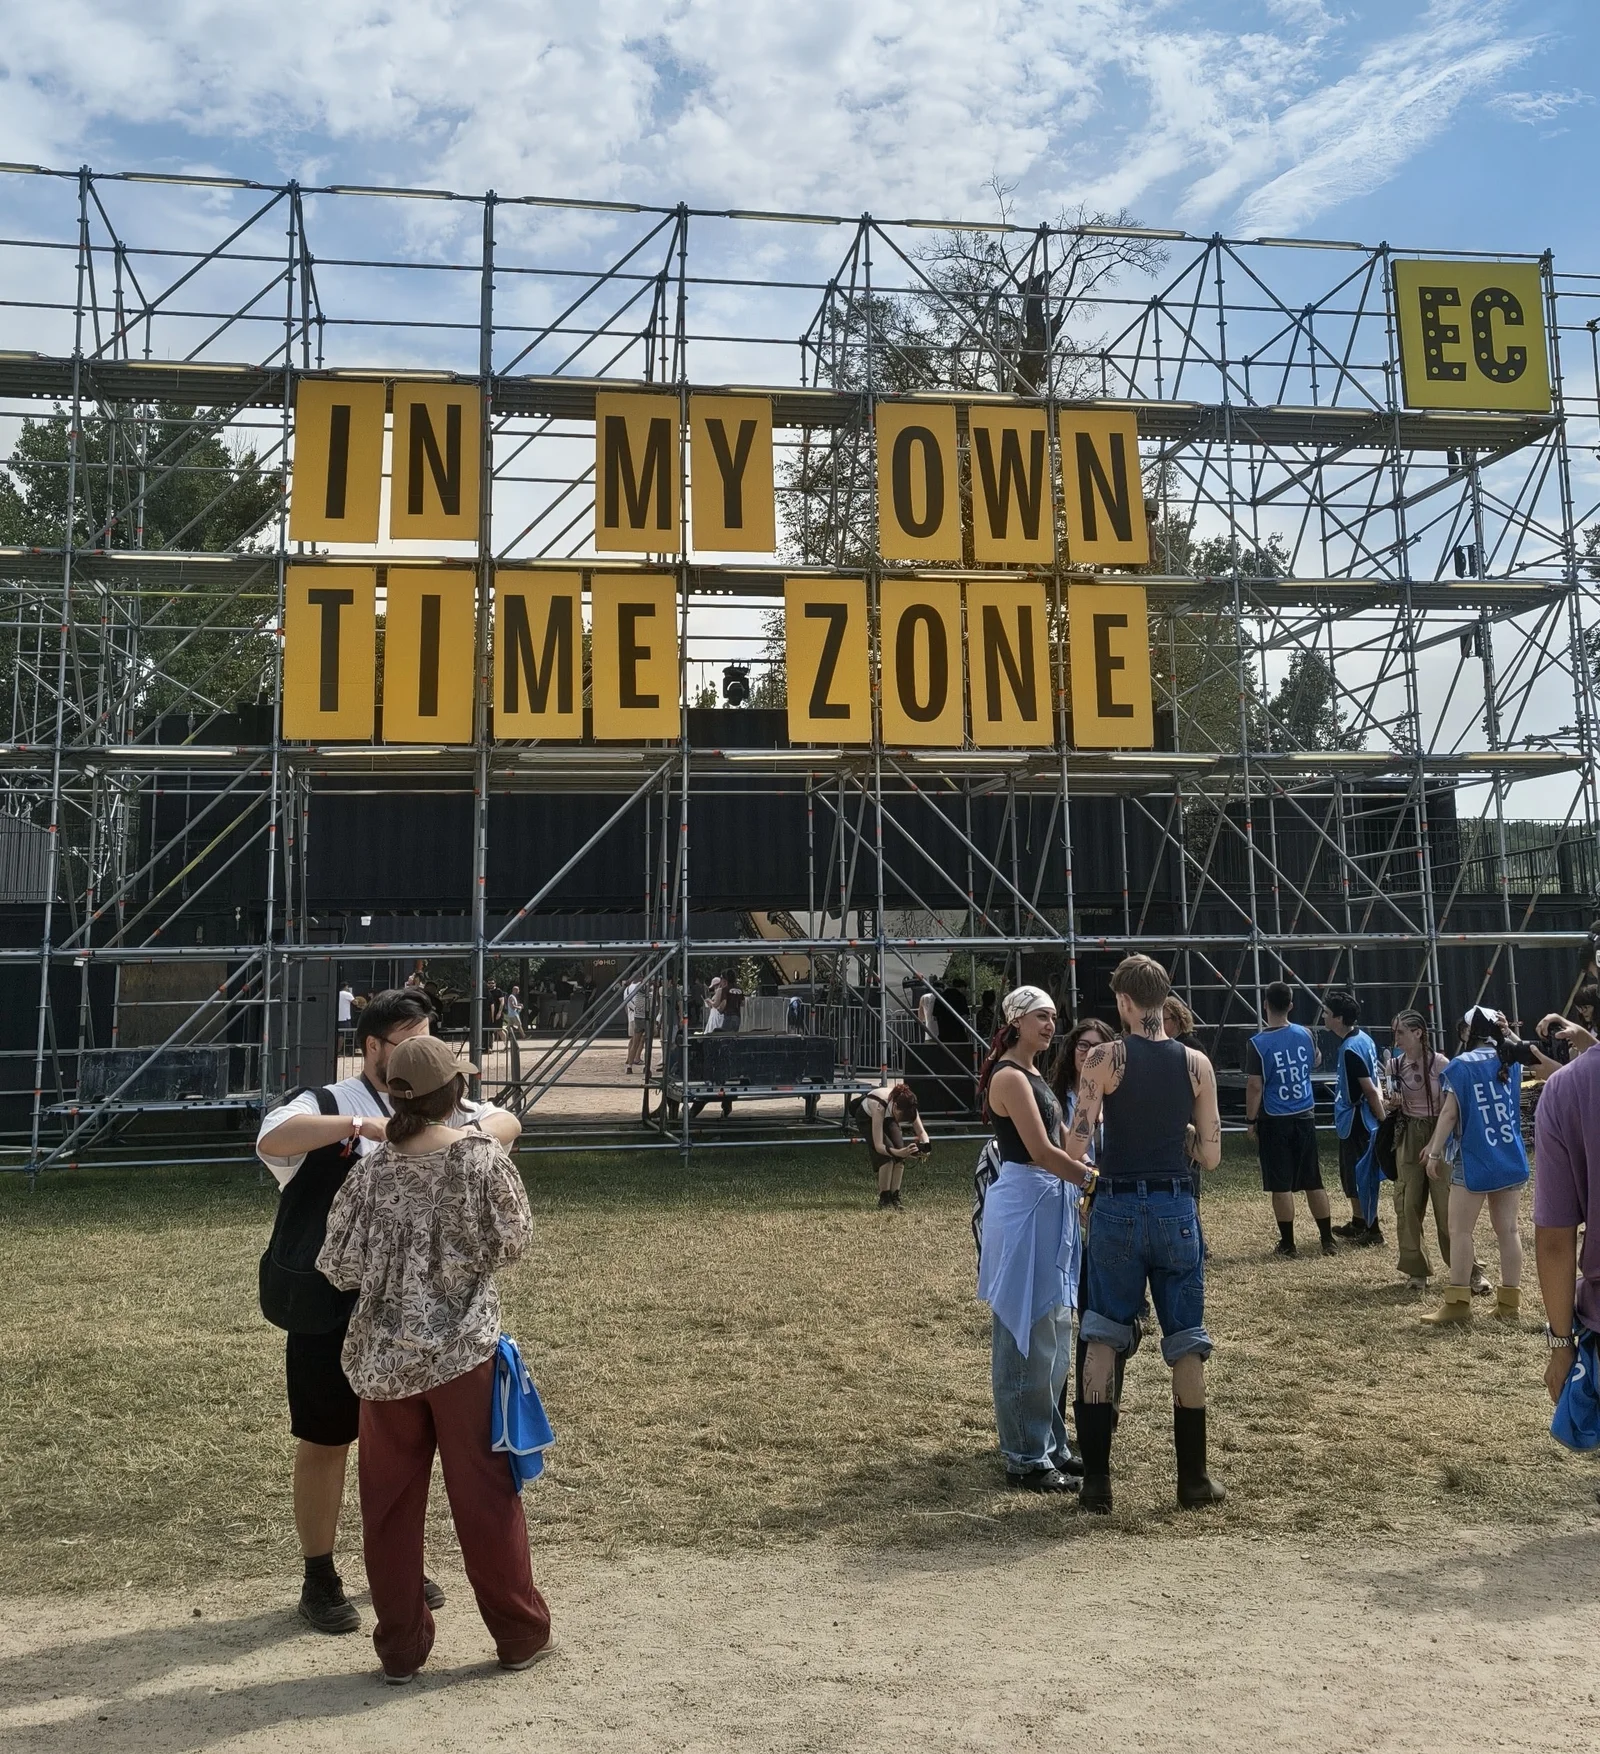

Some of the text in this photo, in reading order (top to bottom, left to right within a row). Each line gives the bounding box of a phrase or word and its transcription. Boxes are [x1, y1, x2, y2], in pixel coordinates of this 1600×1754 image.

[1418, 286, 1527, 383] EC
[325, 403, 1133, 542] IN MY OWN
[308, 588, 1134, 722] TIME ZONE
[1273, 1046, 1308, 1068] ELC
[1276, 1064, 1309, 1084] TRC
[1278, 1080, 1309, 1101] CST
[1485, 1120, 1516, 1147] CS
